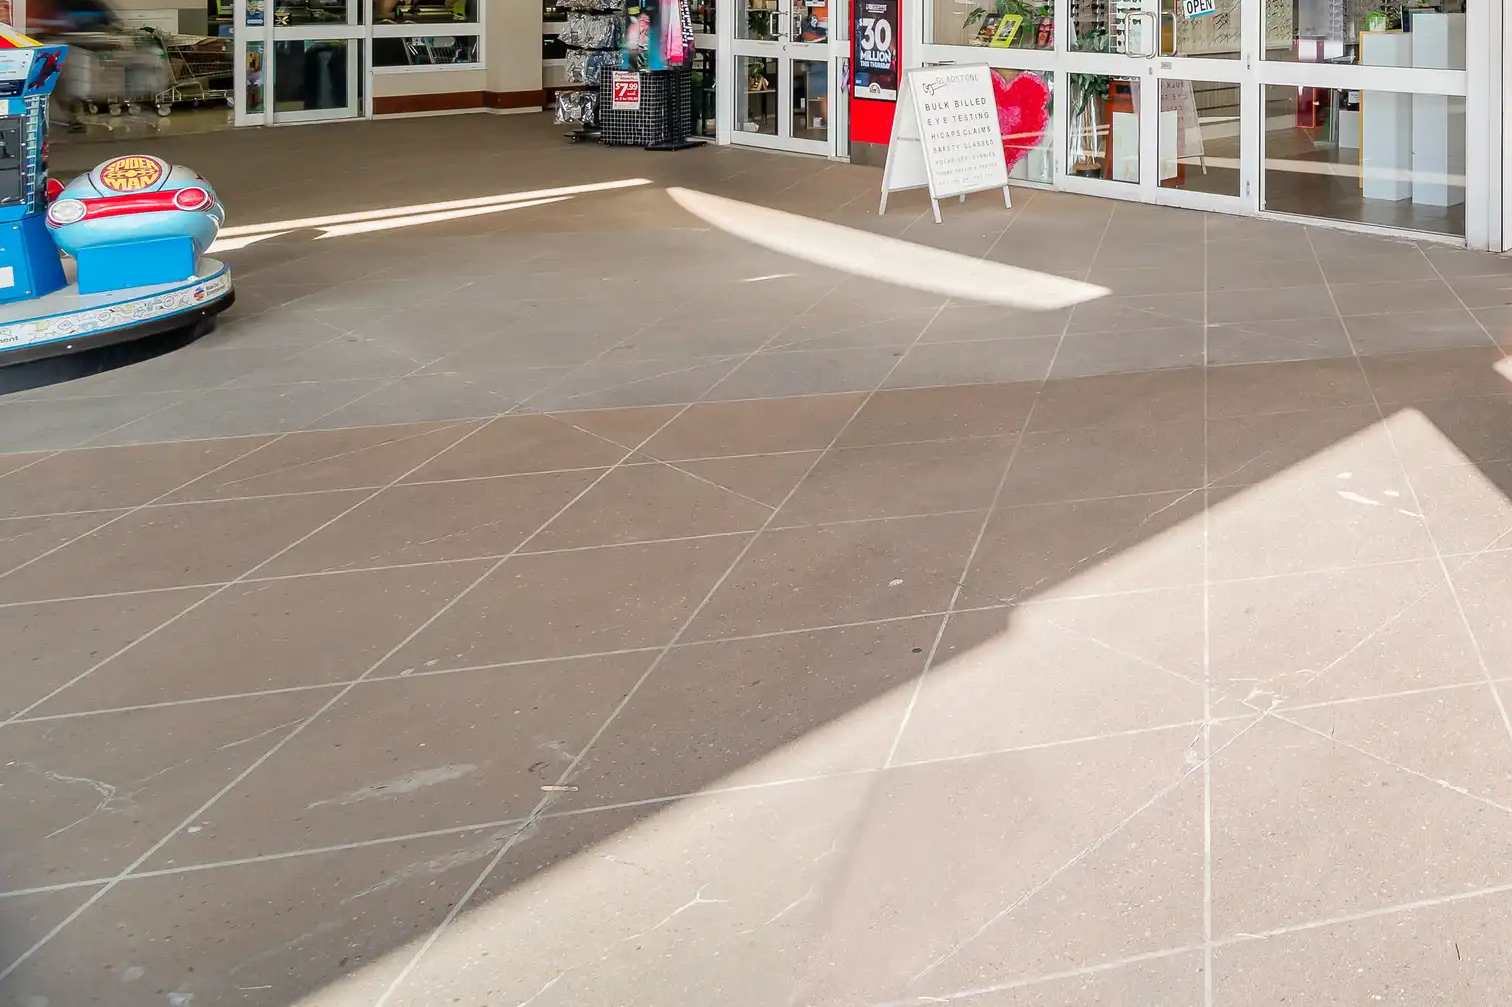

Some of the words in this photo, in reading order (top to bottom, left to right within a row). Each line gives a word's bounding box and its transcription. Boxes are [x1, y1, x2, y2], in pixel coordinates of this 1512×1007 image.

[858, 18, 892, 51] $30
[860, 49, 892, 63] MILLION
[936, 72, 980, 84] GLADSTONE
[615, 82, 638, 97] $7.99
[925, 101, 949, 112] BULK
[954, 97, 987, 108] BILLED
[927, 116, 948, 126] EYE
[952, 111, 990, 122] TESTING
[931, 129, 961, 140] HICAPS
[962, 125, 991, 136] CLAIMS
[963, 139, 994, 149] GLASSES
[106, 157, 158, 173] SPIDER
[102, 173, 160, 191] MAN
